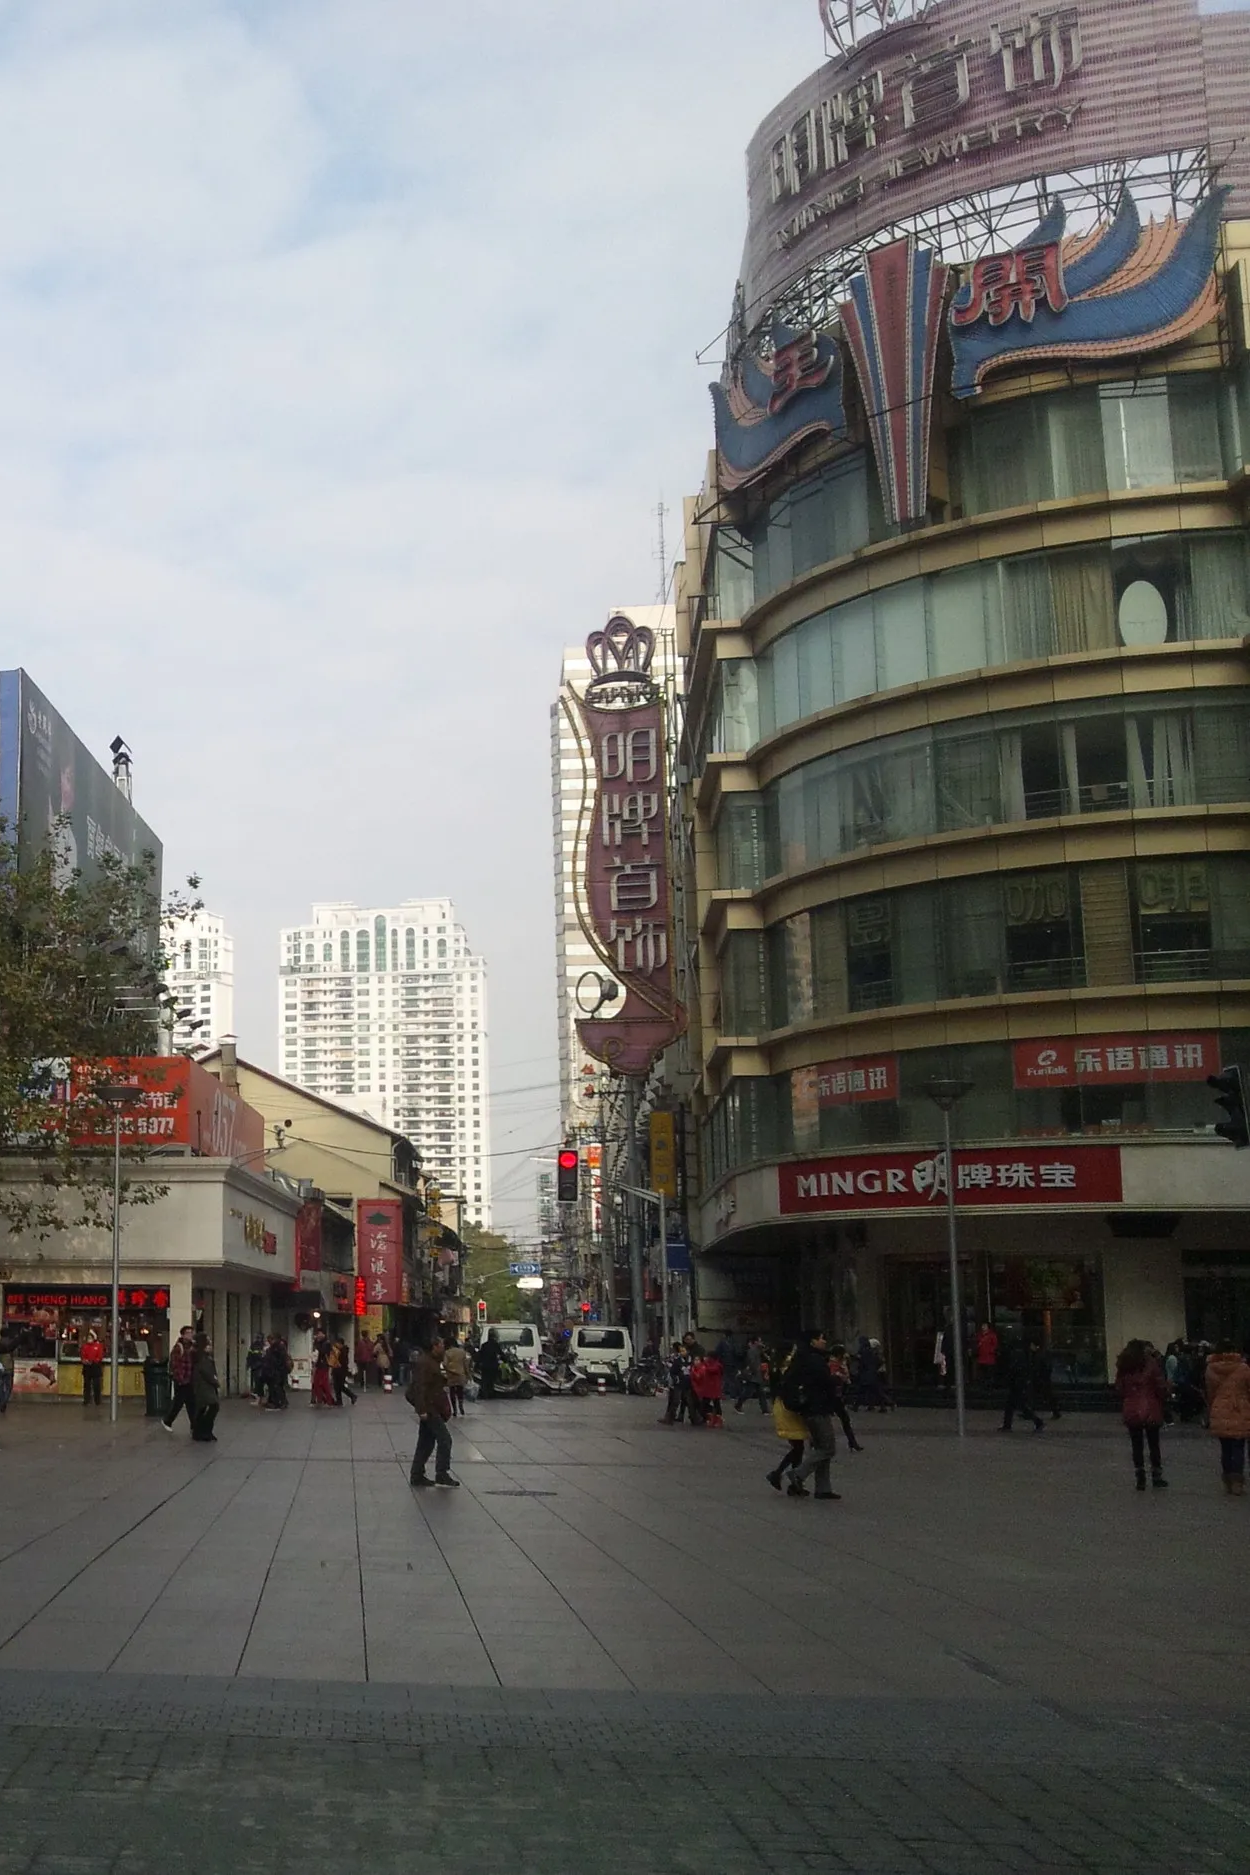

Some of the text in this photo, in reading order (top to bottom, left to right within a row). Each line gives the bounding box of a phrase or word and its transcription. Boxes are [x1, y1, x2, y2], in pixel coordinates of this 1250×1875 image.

[600, 726, 668, 978] 明牌首饰
[1075, 1043, 1204, 1074] 乐语通讯
[796, 1167, 909, 1200] MINGR
[28, 1294, 68, 1306] CHENG
[70, 1294, 108, 1306] HIANG
